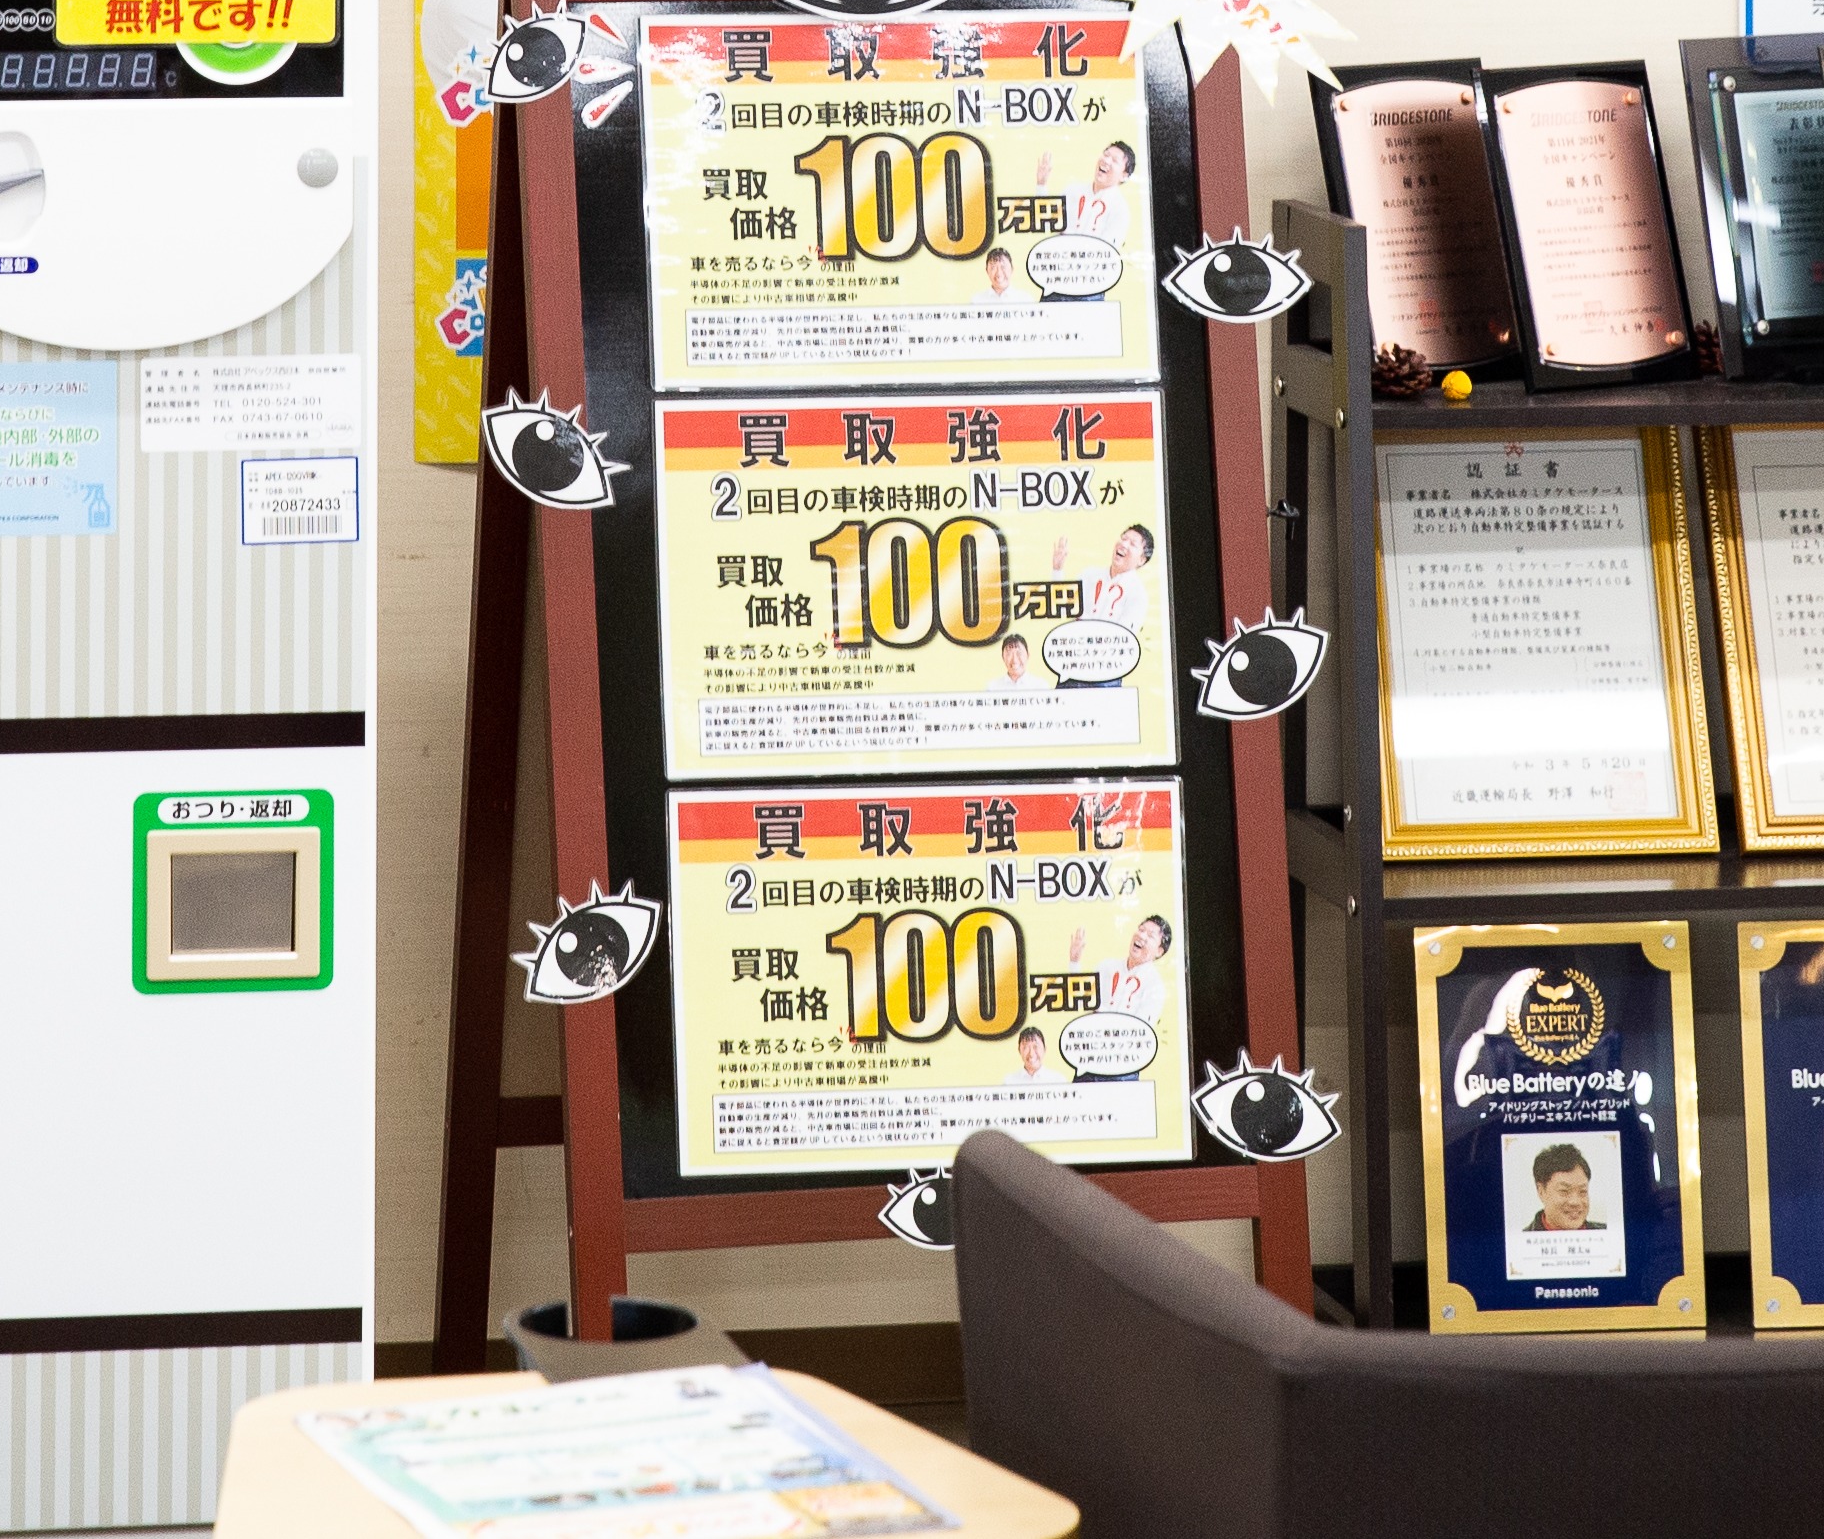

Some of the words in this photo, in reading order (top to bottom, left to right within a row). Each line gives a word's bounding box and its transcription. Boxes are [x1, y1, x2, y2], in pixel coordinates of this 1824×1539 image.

[723, 24, 1089, 81] 買取強化
[1371, 108, 1453, 126] BRIDGESTONE
[702, 168, 768, 201] 買取
[730, 206, 798, 240] 価格
[795, 132, 994, 262] 100
[690, 257, 811, 273] 車を売るなら今
[738, 408, 1107, 469] 買取強化
[272, 498, 341, 513] 20872433
[717, 555, 783, 588] 買取
[745, 594, 812, 628] 価格
[811, 517, 1010, 649] 100
[704, 644, 827, 661] 車を売るなら今
[755, 796, 1123, 859] 買取強化
[732, 948, 798, 981] 買取
[760, 988, 829, 1022] 価格
[827, 909, 1026, 1043] 100
[1526, 1014, 1588, 1033] EXPERT
[718, 1038, 843, 1056] 車を売るなら今
[1535, 1285, 1599, 1299] Panasonic
